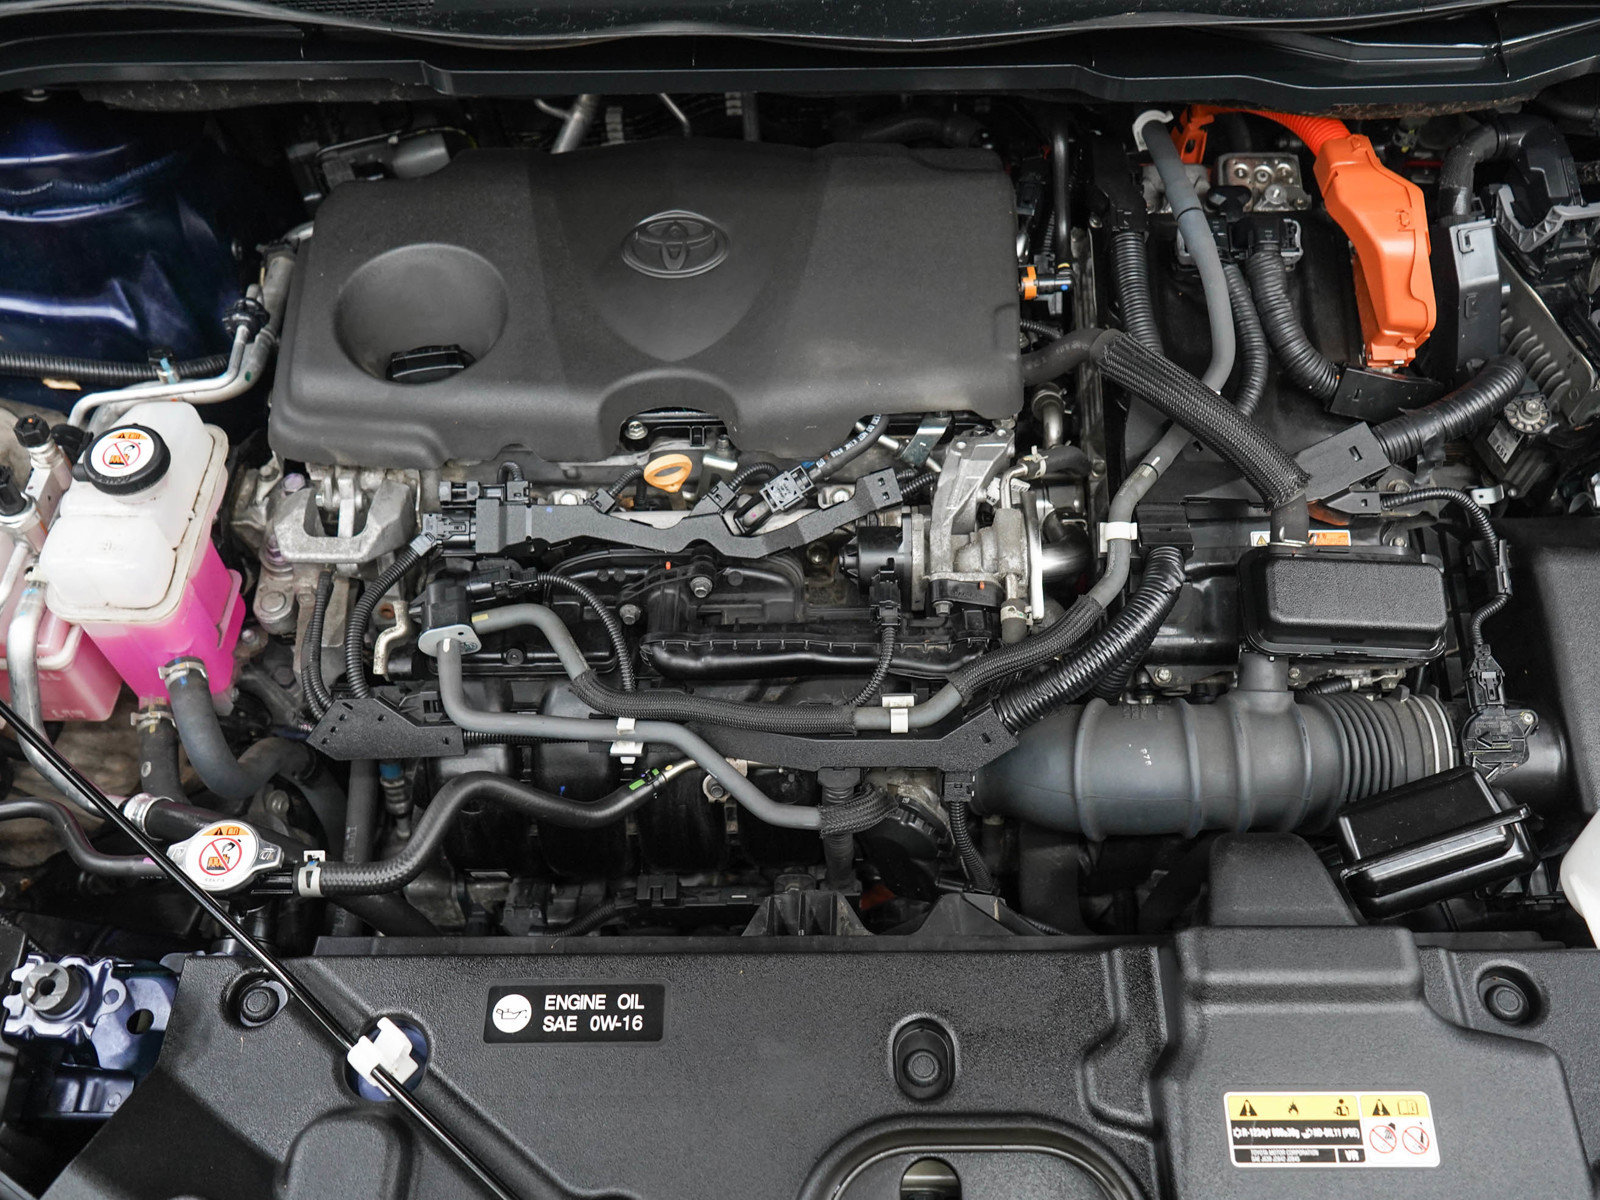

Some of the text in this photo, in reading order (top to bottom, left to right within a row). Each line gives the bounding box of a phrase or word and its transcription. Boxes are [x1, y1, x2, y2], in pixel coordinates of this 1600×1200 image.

[544, 993, 644, 1010] ENGINE OIL
[542, 1015, 643, 1032] SAE 0W-16
